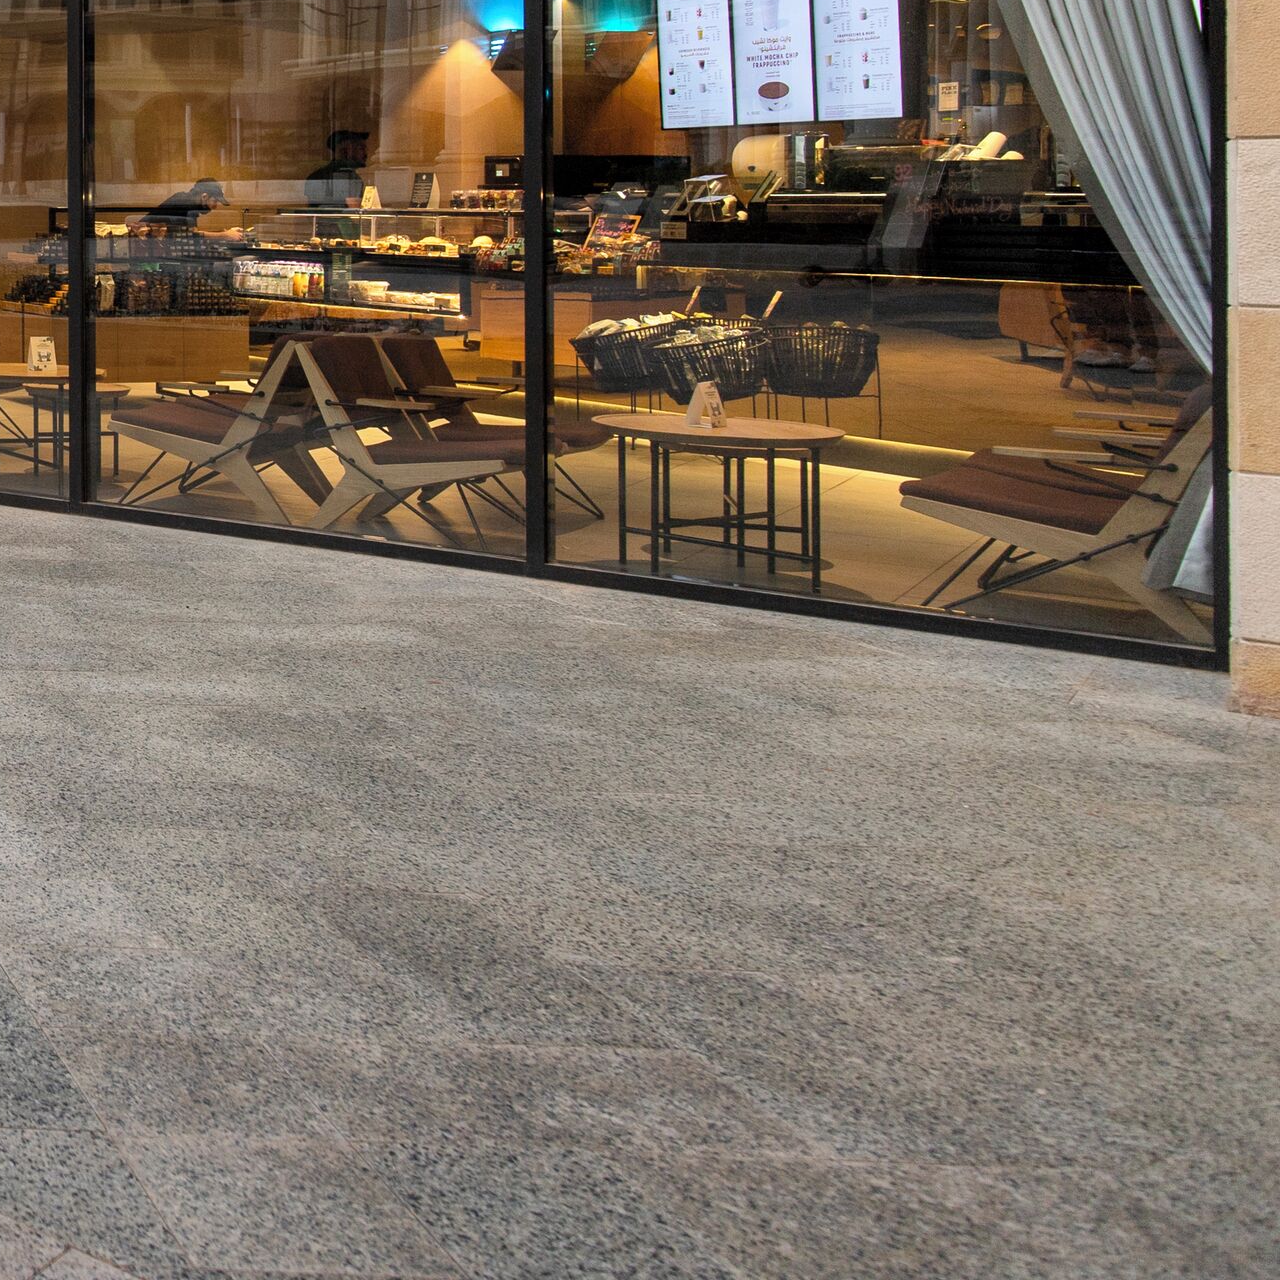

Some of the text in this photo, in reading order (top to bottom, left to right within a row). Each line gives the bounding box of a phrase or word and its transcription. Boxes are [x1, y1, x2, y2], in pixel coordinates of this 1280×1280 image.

[746, 51, 799, 62] WHITE MOCHA CHIP
